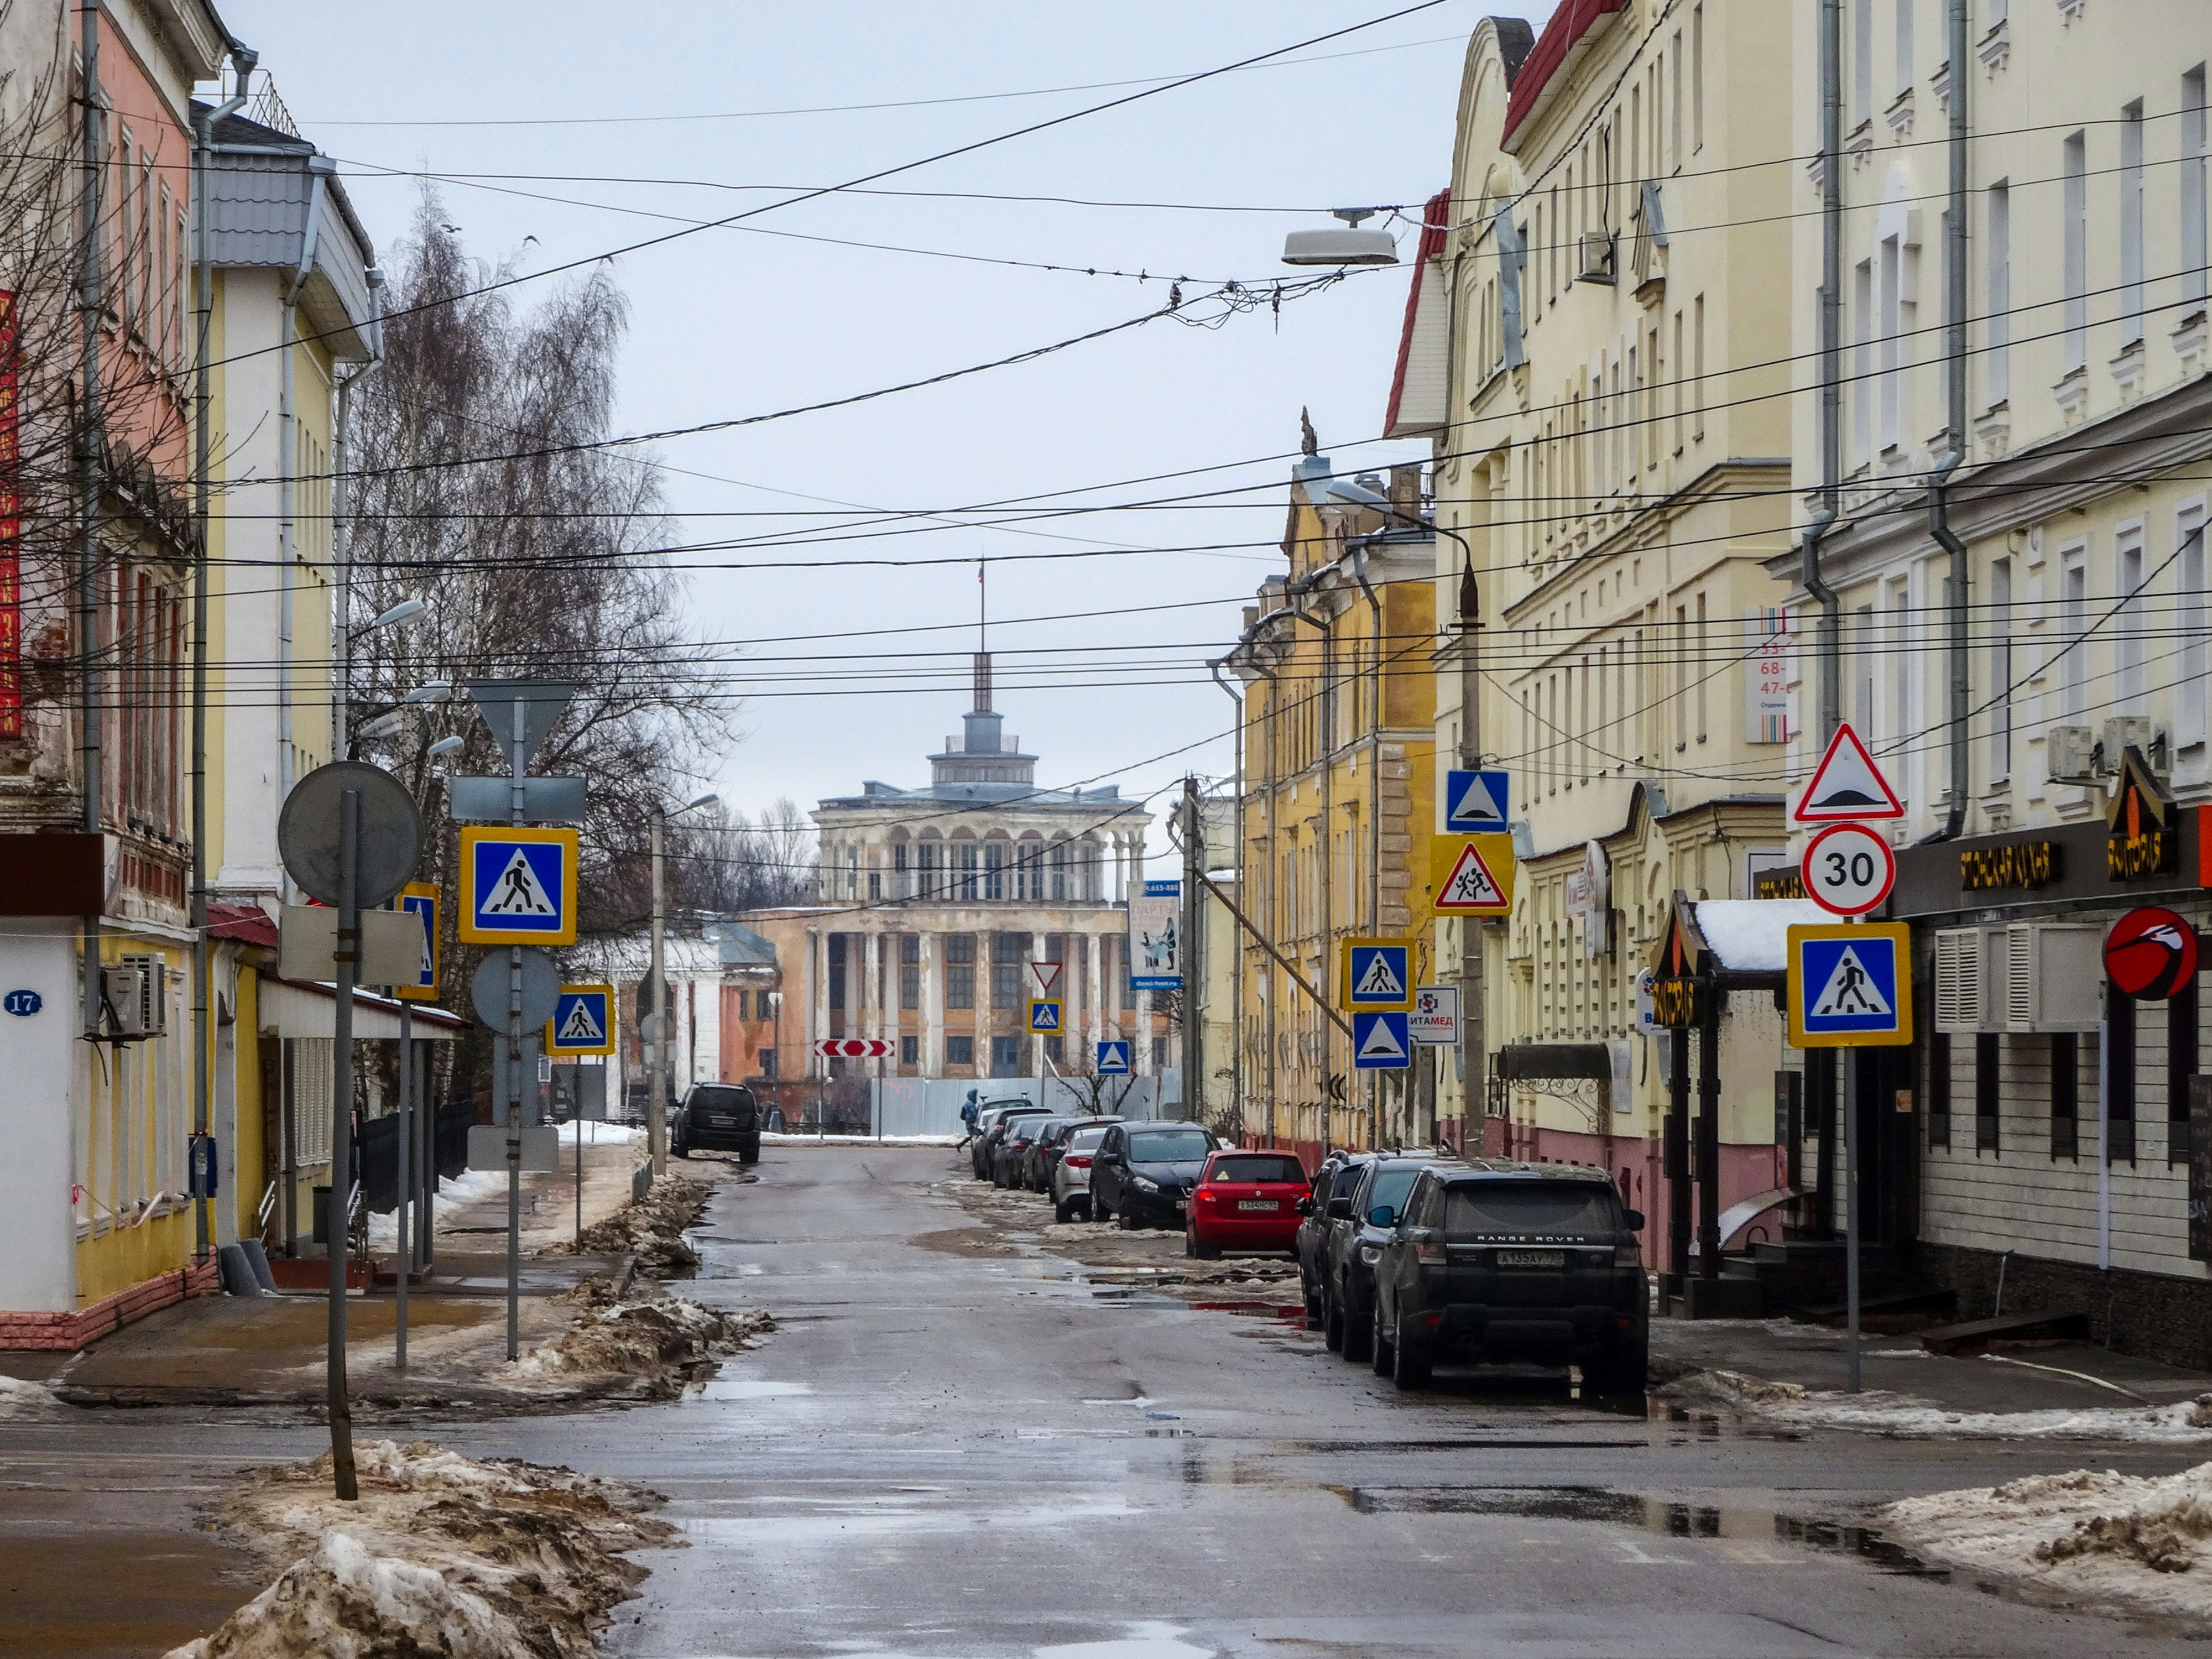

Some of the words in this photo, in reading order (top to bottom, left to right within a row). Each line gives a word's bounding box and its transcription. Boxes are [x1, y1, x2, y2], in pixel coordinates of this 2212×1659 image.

[1825, 852, 1874, 886] 30
[11, 995, 33, 1012] 17
[1409, 1016, 1453, 1027] ИТАМЕД
